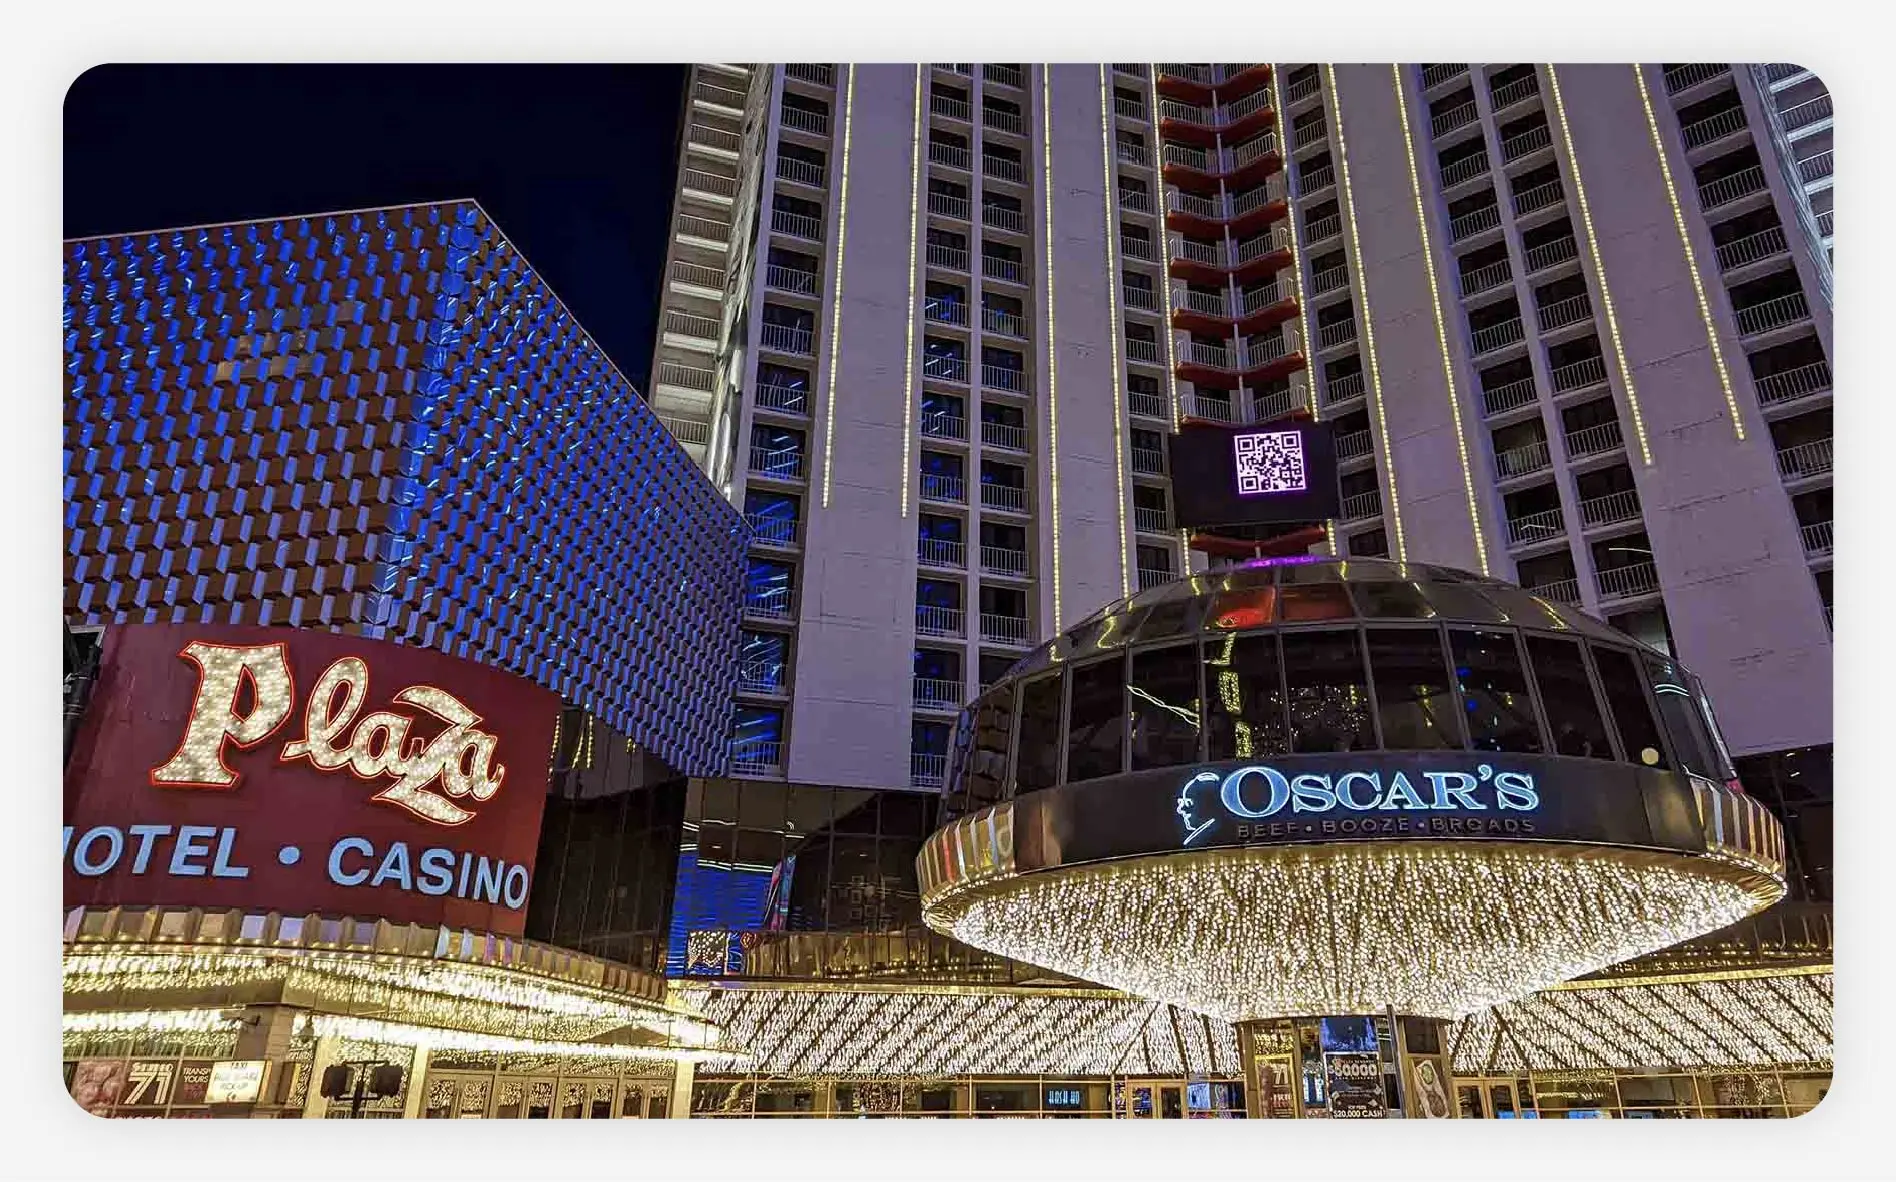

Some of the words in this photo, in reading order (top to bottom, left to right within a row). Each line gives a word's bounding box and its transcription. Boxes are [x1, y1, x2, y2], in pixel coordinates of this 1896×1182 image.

[148, 640, 506, 825] Plaza
[1220, 763, 1540, 818] OSCAR'S
[1238, 821, 1298, 838] BEEF
[1322, 817, 1409, 833] BOOZE
[1431, 817, 1536, 833] BROADS
[327, 836, 530, 909] CASINO
[123, 1071, 173, 1105] 71
[1361, 1109, 1383, 1118] CASH
